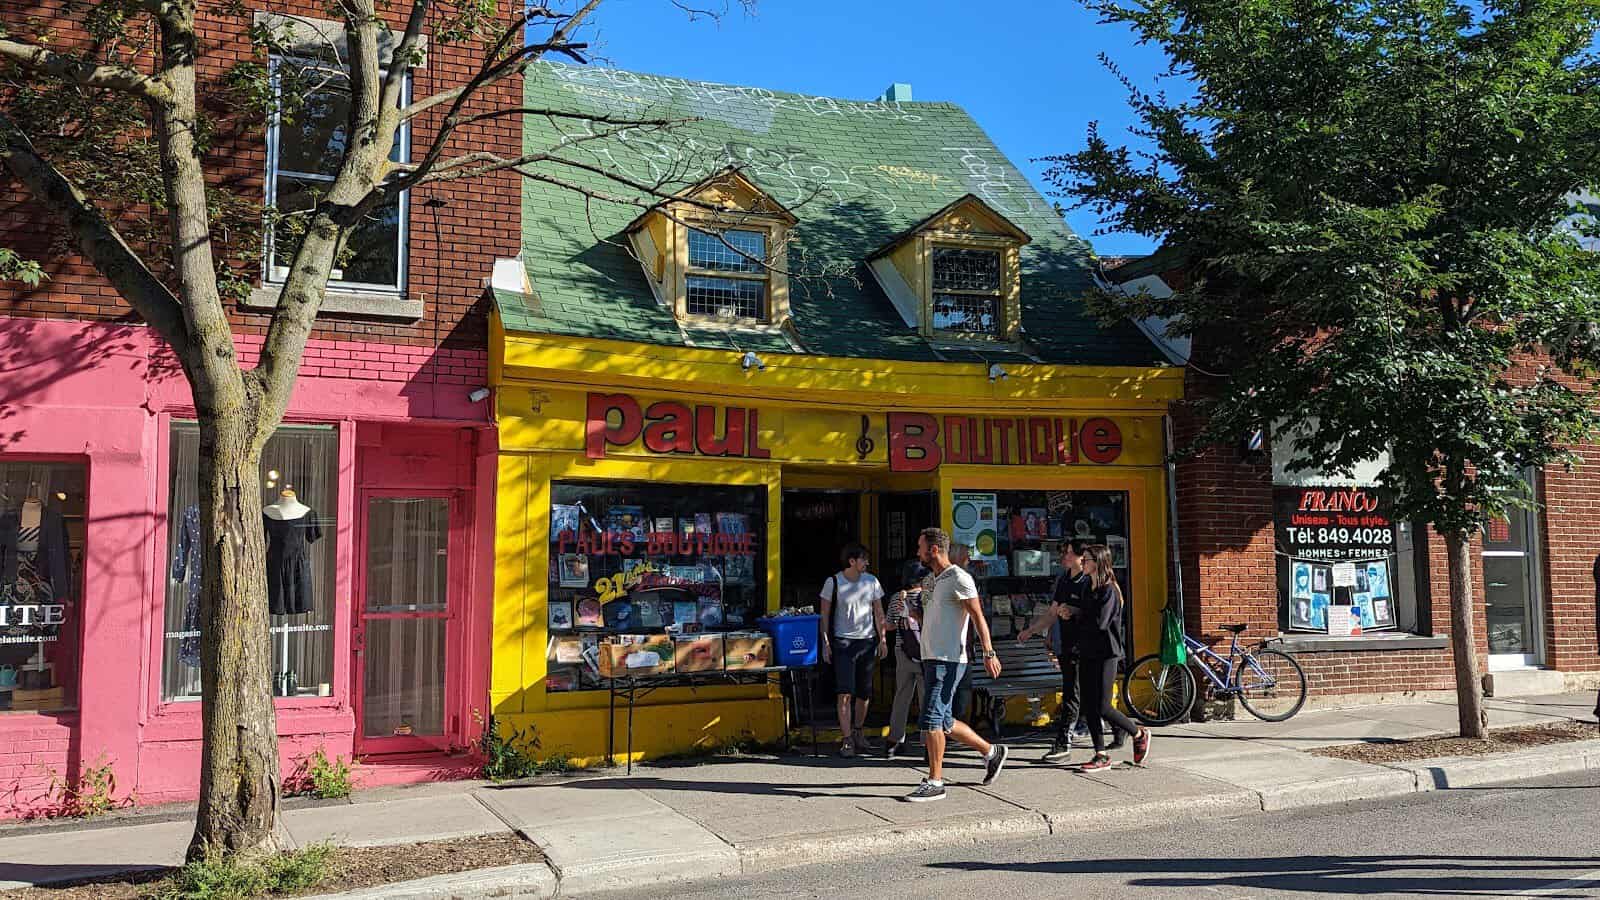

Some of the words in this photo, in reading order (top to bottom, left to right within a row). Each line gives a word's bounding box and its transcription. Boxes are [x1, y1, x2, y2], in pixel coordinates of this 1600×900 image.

[1298, 490, 1379, 512] FRANCO
[1291, 514, 1329, 526] Unisexe
[1337, 514, 1359, 526] Tous
[646, 530, 755, 556] BOUTIQUE
[1286, 528, 1315, 544] Tél:
[1318, 528, 1392, 544] 849.4028
[1298, 549, 1340, 558] HOMMES
[1348, 548, 1388, 557] FEMMES
[594, 571, 629, 606] 21
